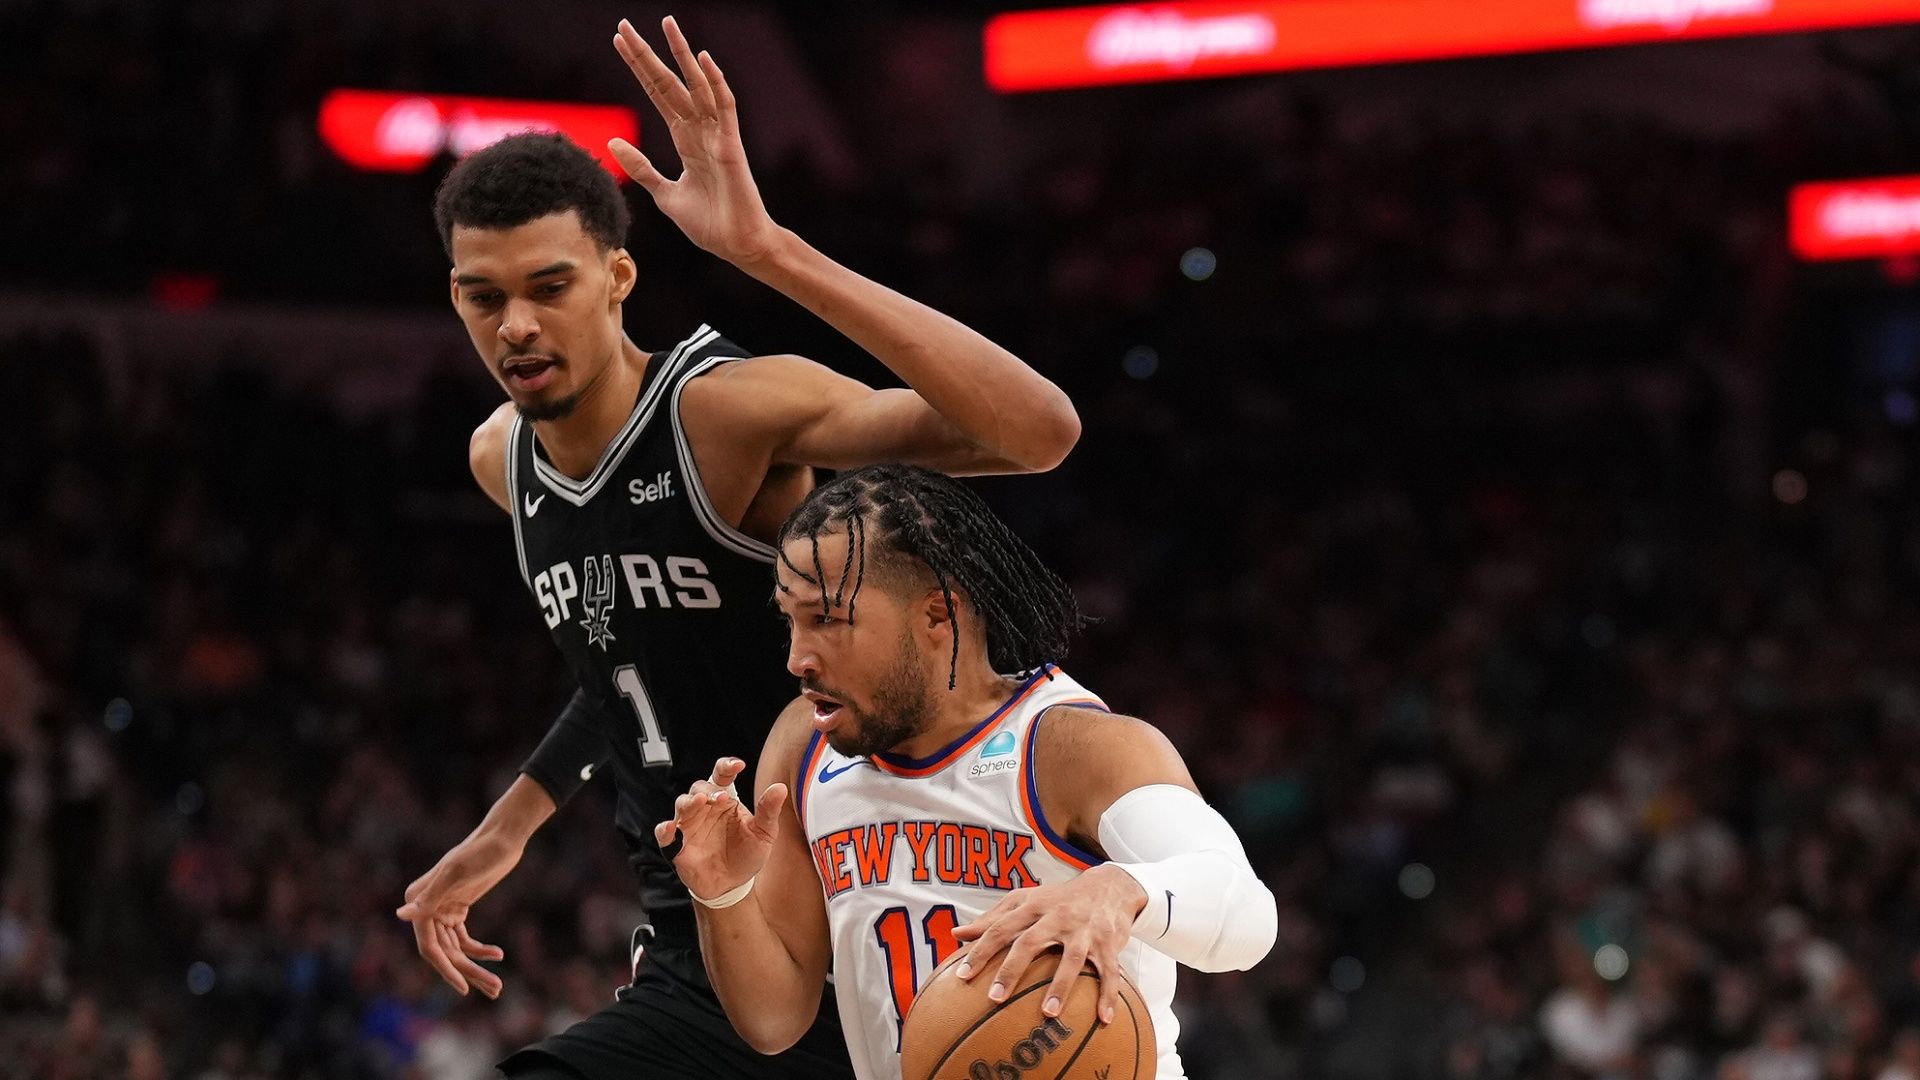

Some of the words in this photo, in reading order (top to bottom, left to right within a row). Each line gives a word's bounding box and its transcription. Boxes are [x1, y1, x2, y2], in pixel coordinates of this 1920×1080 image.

[628, 470, 675, 505] Self.
[534, 554, 722, 650] SPURS
[612, 663, 673, 767] 1
[971, 759, 1018, 776] sphere
[812, 820, 899, 900] NEW
[902, 820, 1041, 891] YORK
